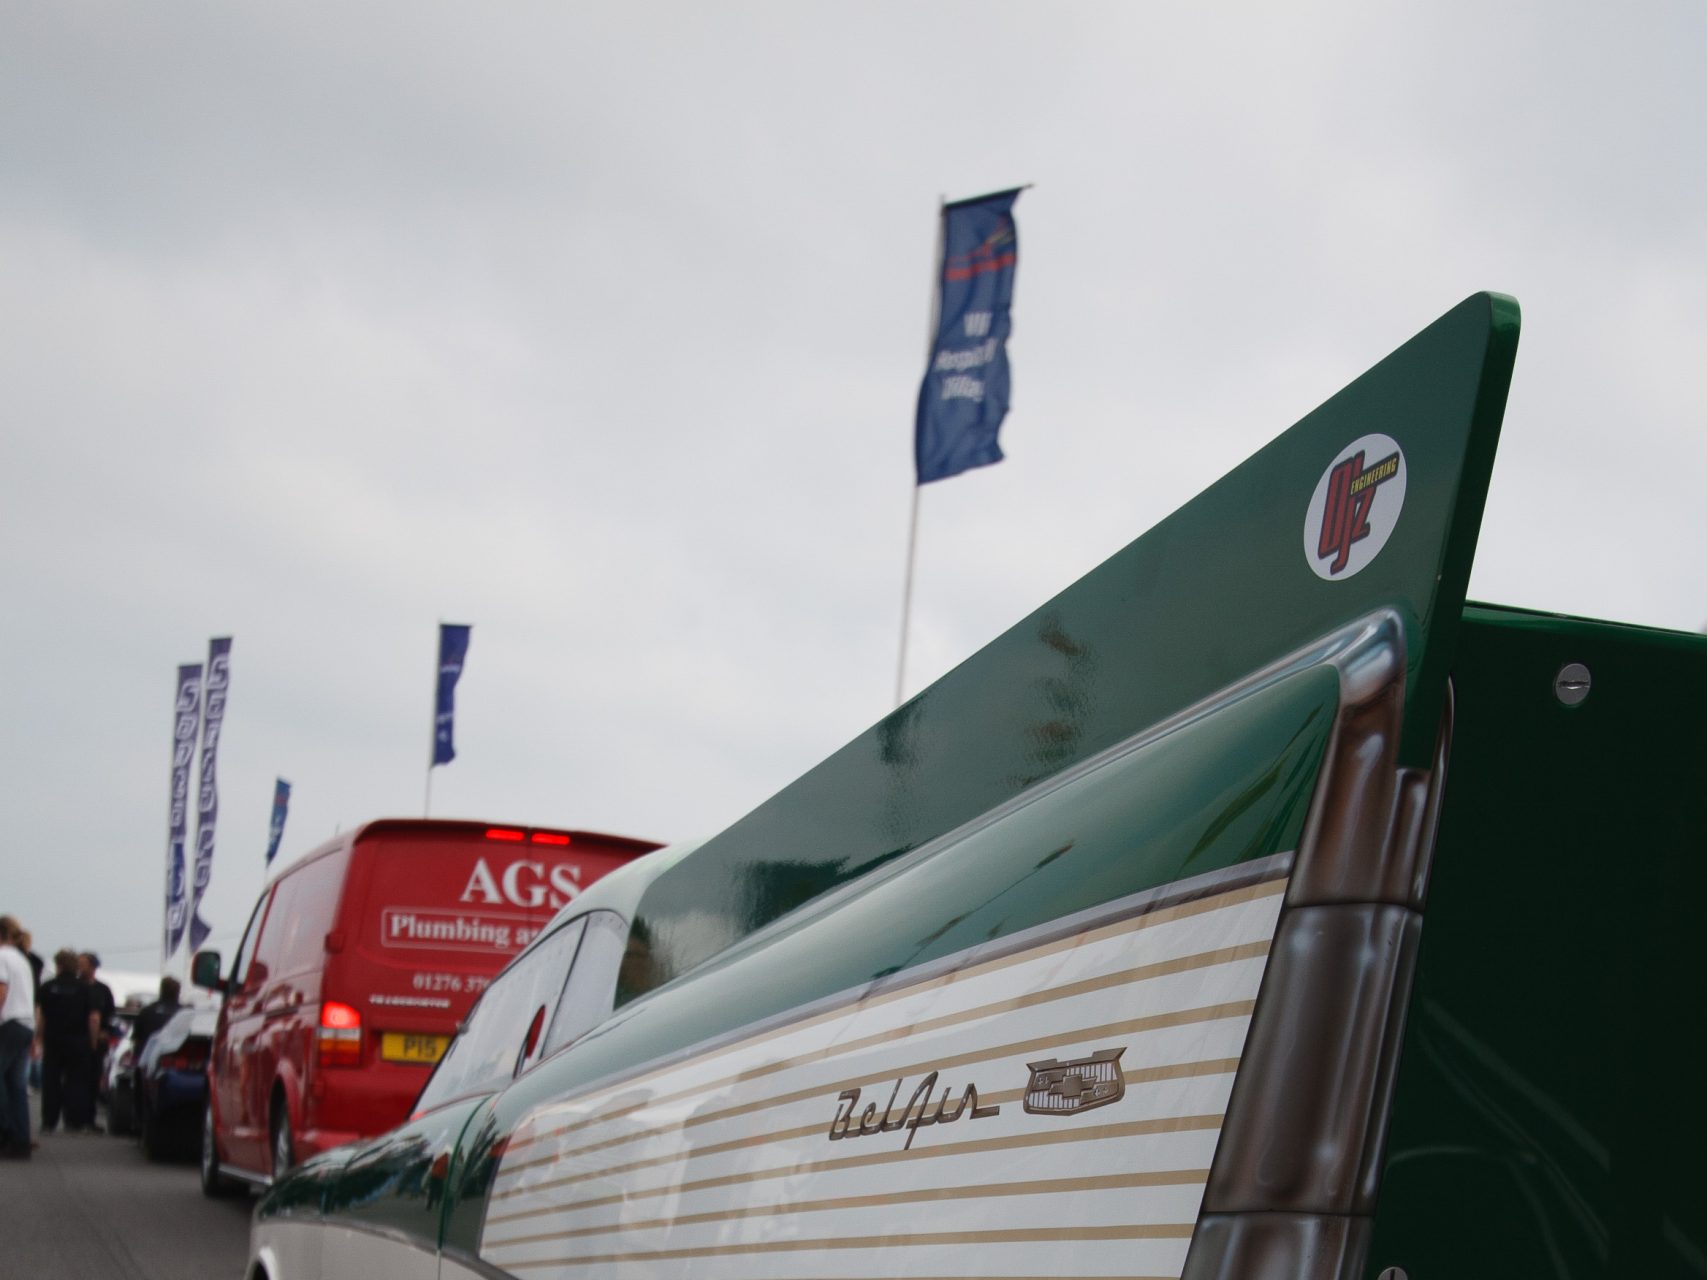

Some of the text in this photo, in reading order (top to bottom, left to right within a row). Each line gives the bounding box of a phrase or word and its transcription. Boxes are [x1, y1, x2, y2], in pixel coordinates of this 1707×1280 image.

[1350, 457, 1397, 495] ENGINEERING
[459, 856, 582, 909] AGS
[390, 913, 510, 947] Plumbing
